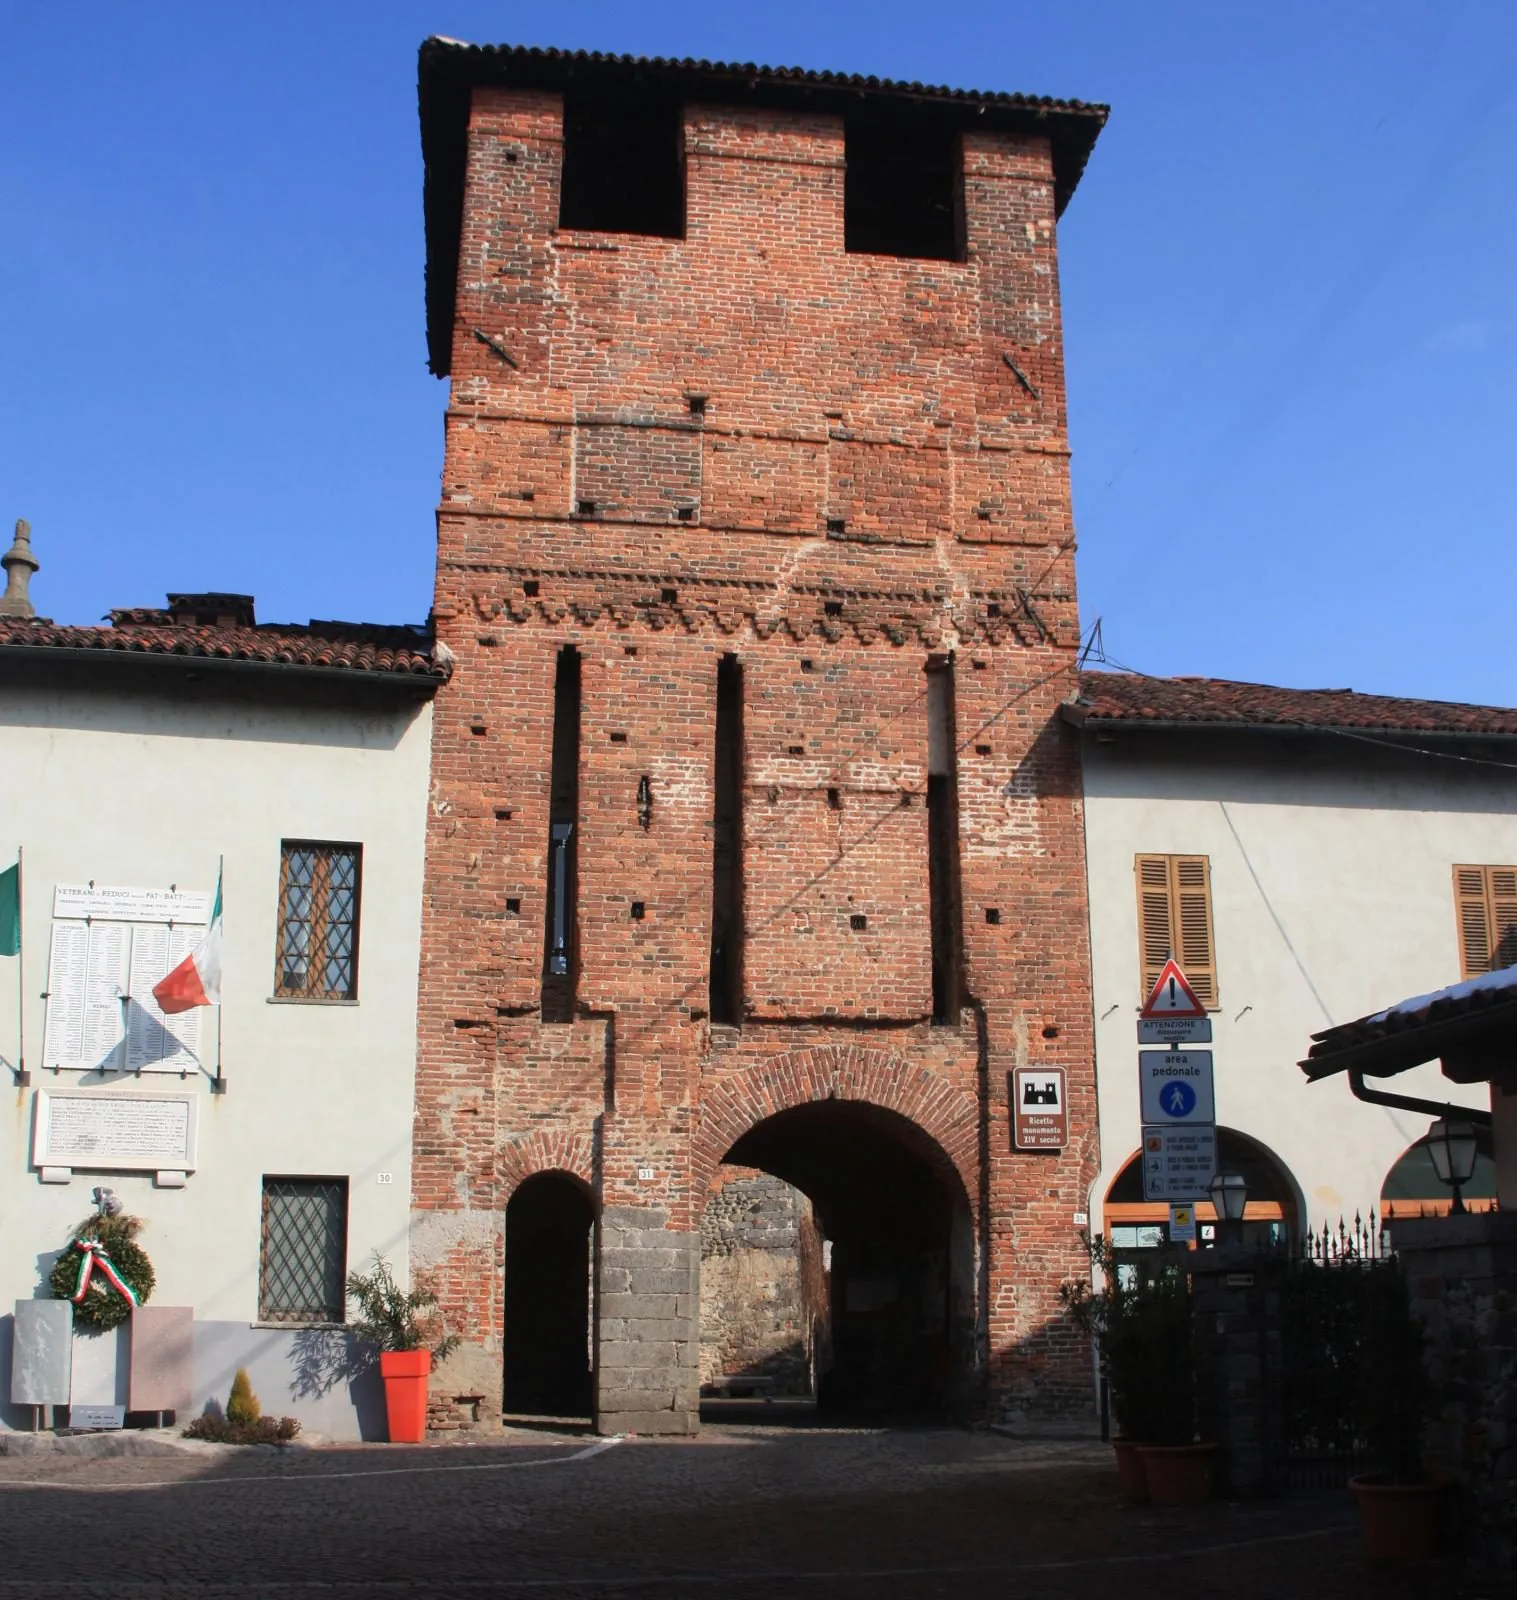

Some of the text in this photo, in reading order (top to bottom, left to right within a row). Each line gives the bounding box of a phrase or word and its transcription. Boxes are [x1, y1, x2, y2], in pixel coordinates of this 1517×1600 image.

[58, 889, 95, 897] VETERANI
[102, 890, 129, 898] REDUCI
[1152, 1066, 1201, 1077] pedonale
[1029, 1117, 1054, 1125] Ricetto
[1040, 1135, 1061, 1143] secolo
[379, 1174, 390, 1182] 30
[640, 1170, 650, 1178] 31
